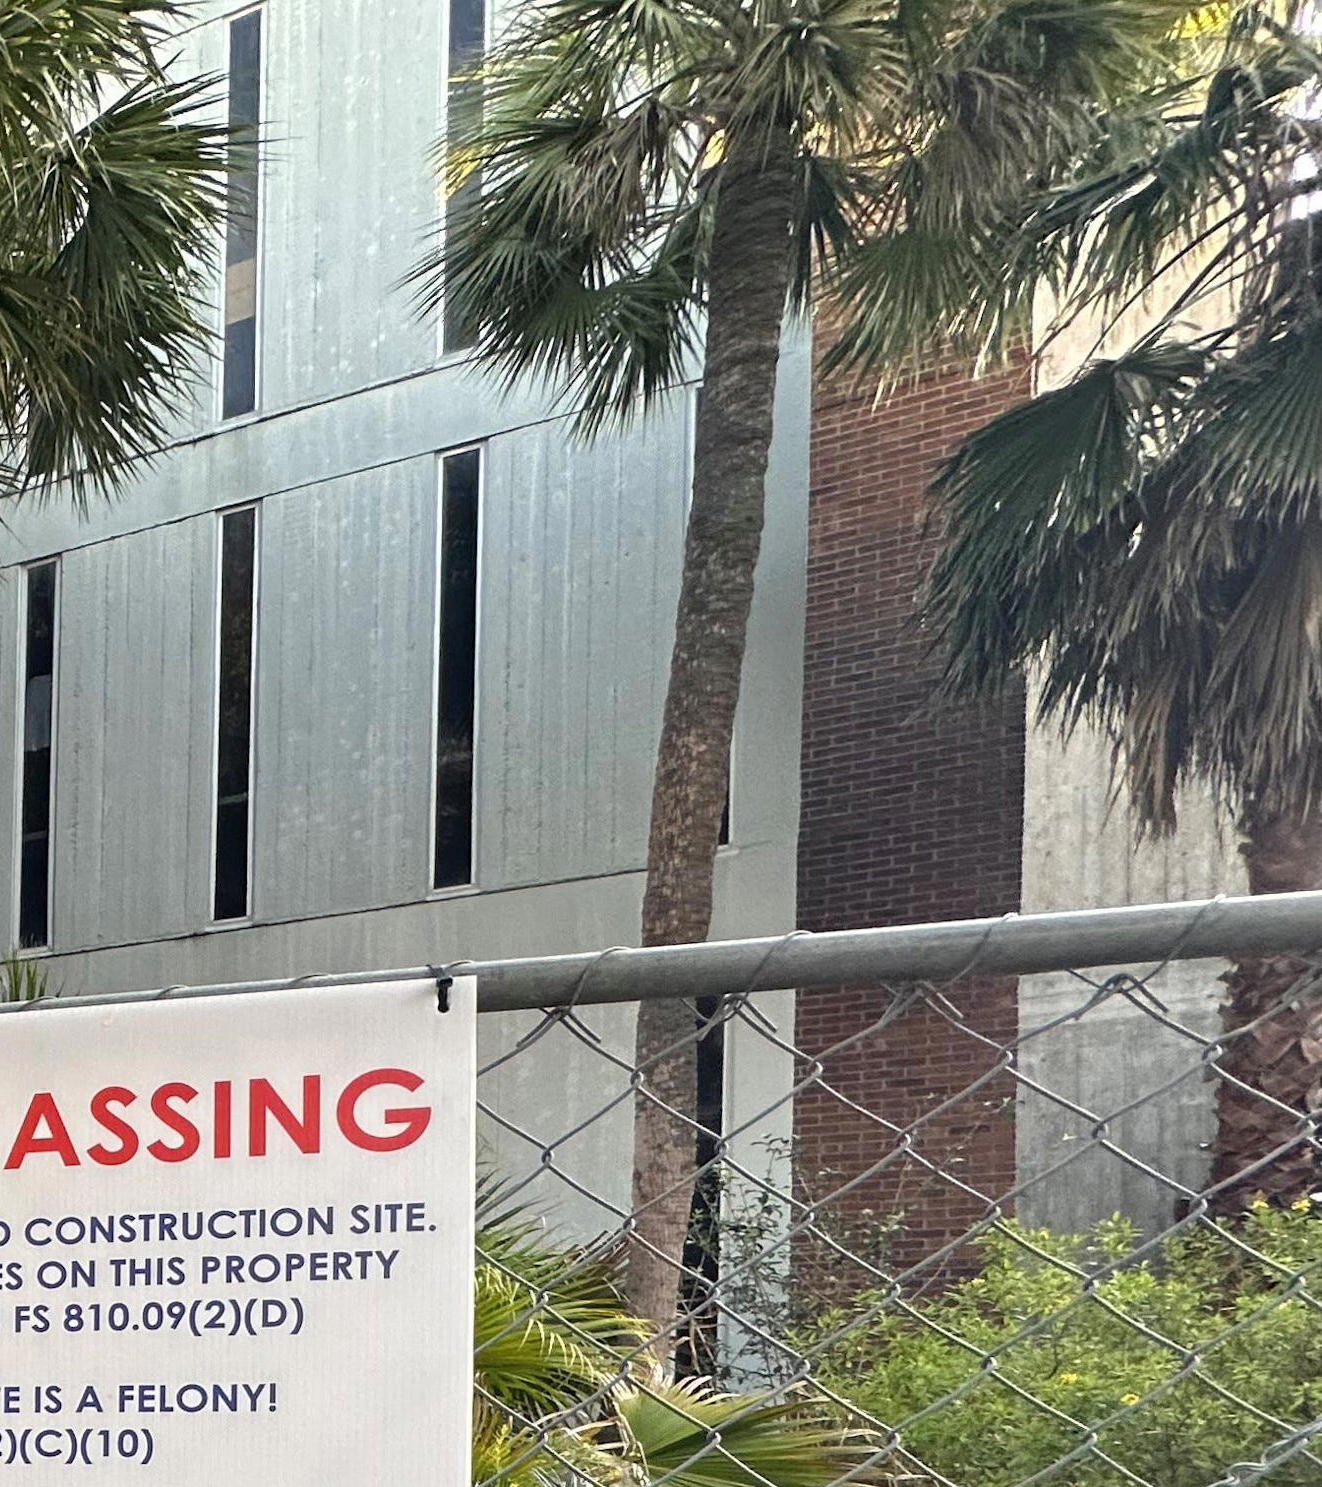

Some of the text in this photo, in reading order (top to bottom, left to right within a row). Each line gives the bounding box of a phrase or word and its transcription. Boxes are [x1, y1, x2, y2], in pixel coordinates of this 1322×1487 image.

[25, 1207, 333, 1246] CONSTRUCTION
[350, 1203, 436, 1234] SITE.
[37, 1260, 95, 1289] ON
[110, 1257, 185, 1286] THIS
[202, 1250, 399, 1284] PROPERTY
[15, 1305, 49, 1333] FS
[64, 1298, 303, 1336] 810.09(2)(D)
[35, 1386, 62, 1413] IS
[76, 1386, 103, 1413] A
[119, 1383, 276, 1412] FELONY!
